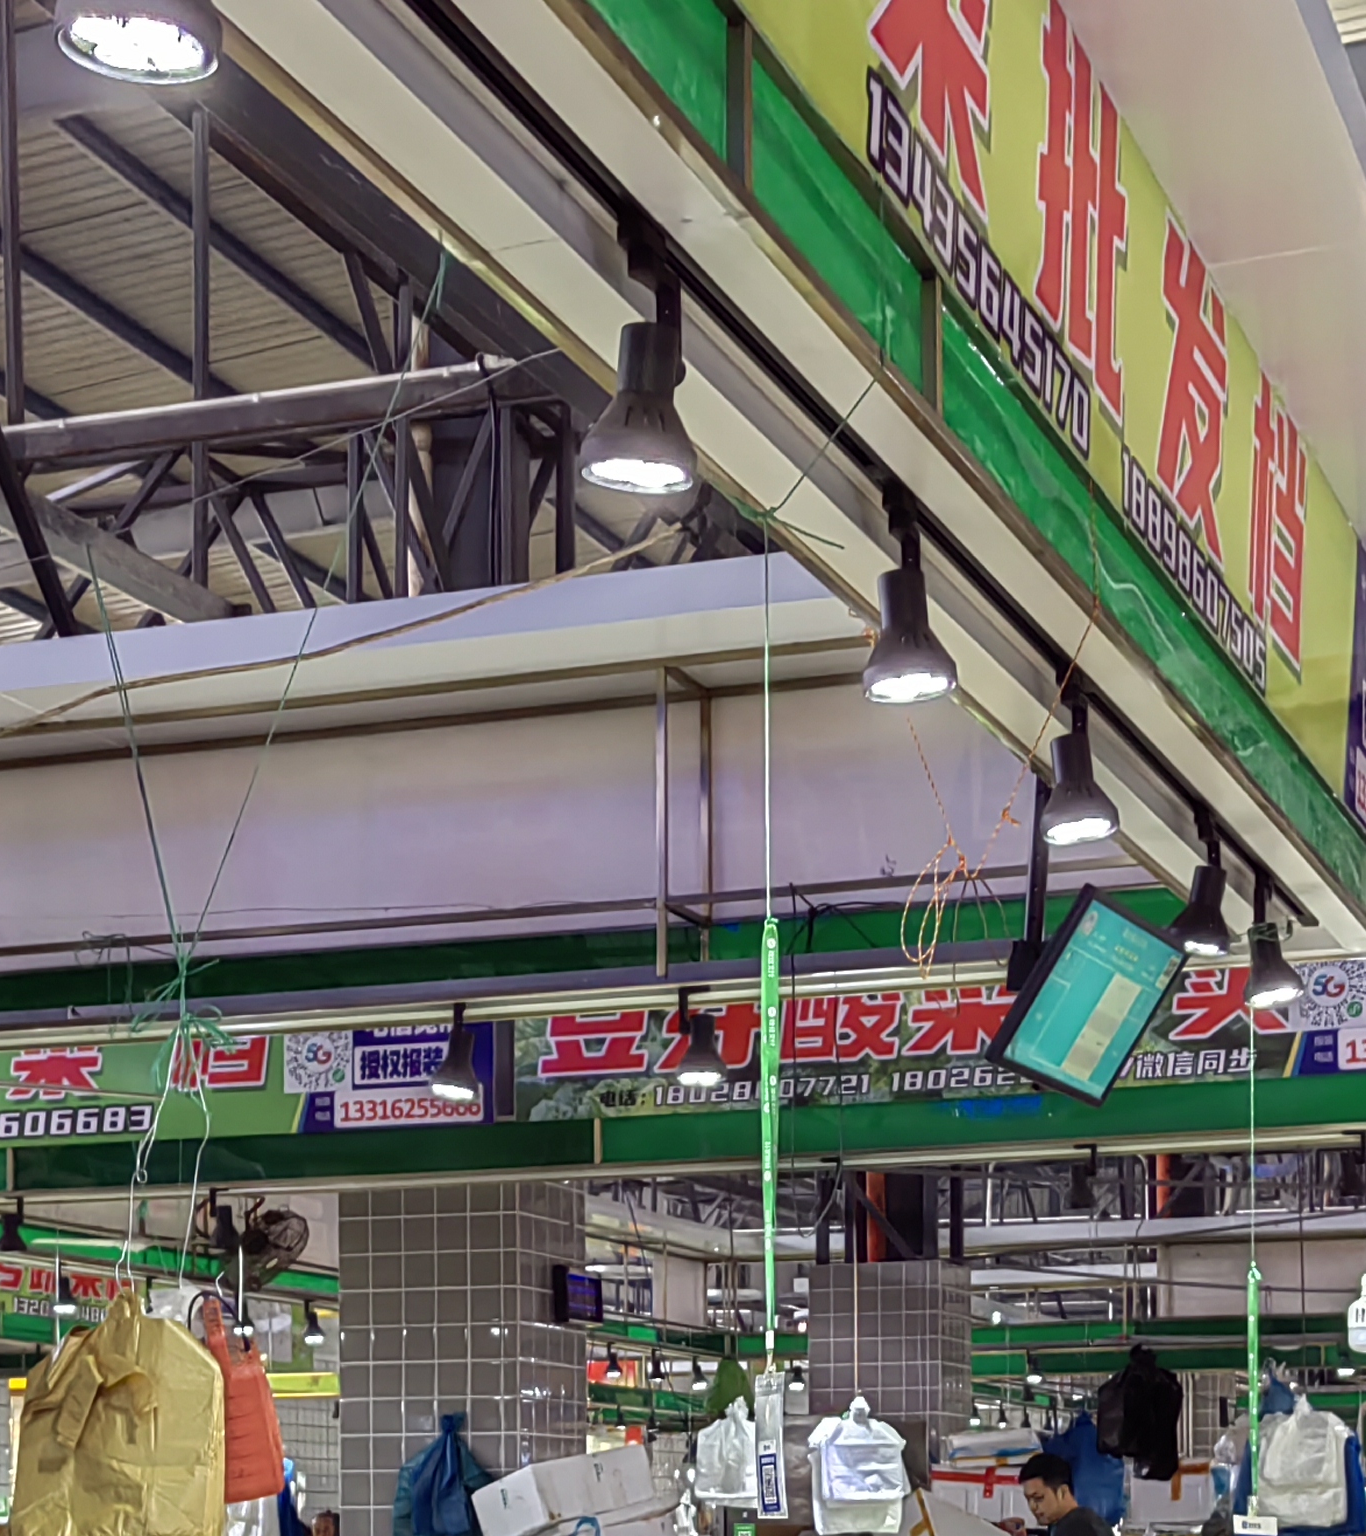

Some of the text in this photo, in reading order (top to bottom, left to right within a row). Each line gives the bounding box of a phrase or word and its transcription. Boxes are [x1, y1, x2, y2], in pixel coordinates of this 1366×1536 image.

[868, 72, 1090, 458] 13435645170
[1123, 448, 1267, 693] 18898607505
[359, 1046, 443, 1081] 授权报装
[538, 970, 1291, 1078] 豆芽酸菜头
[653, 1073, 871, 1106] 1802807721
